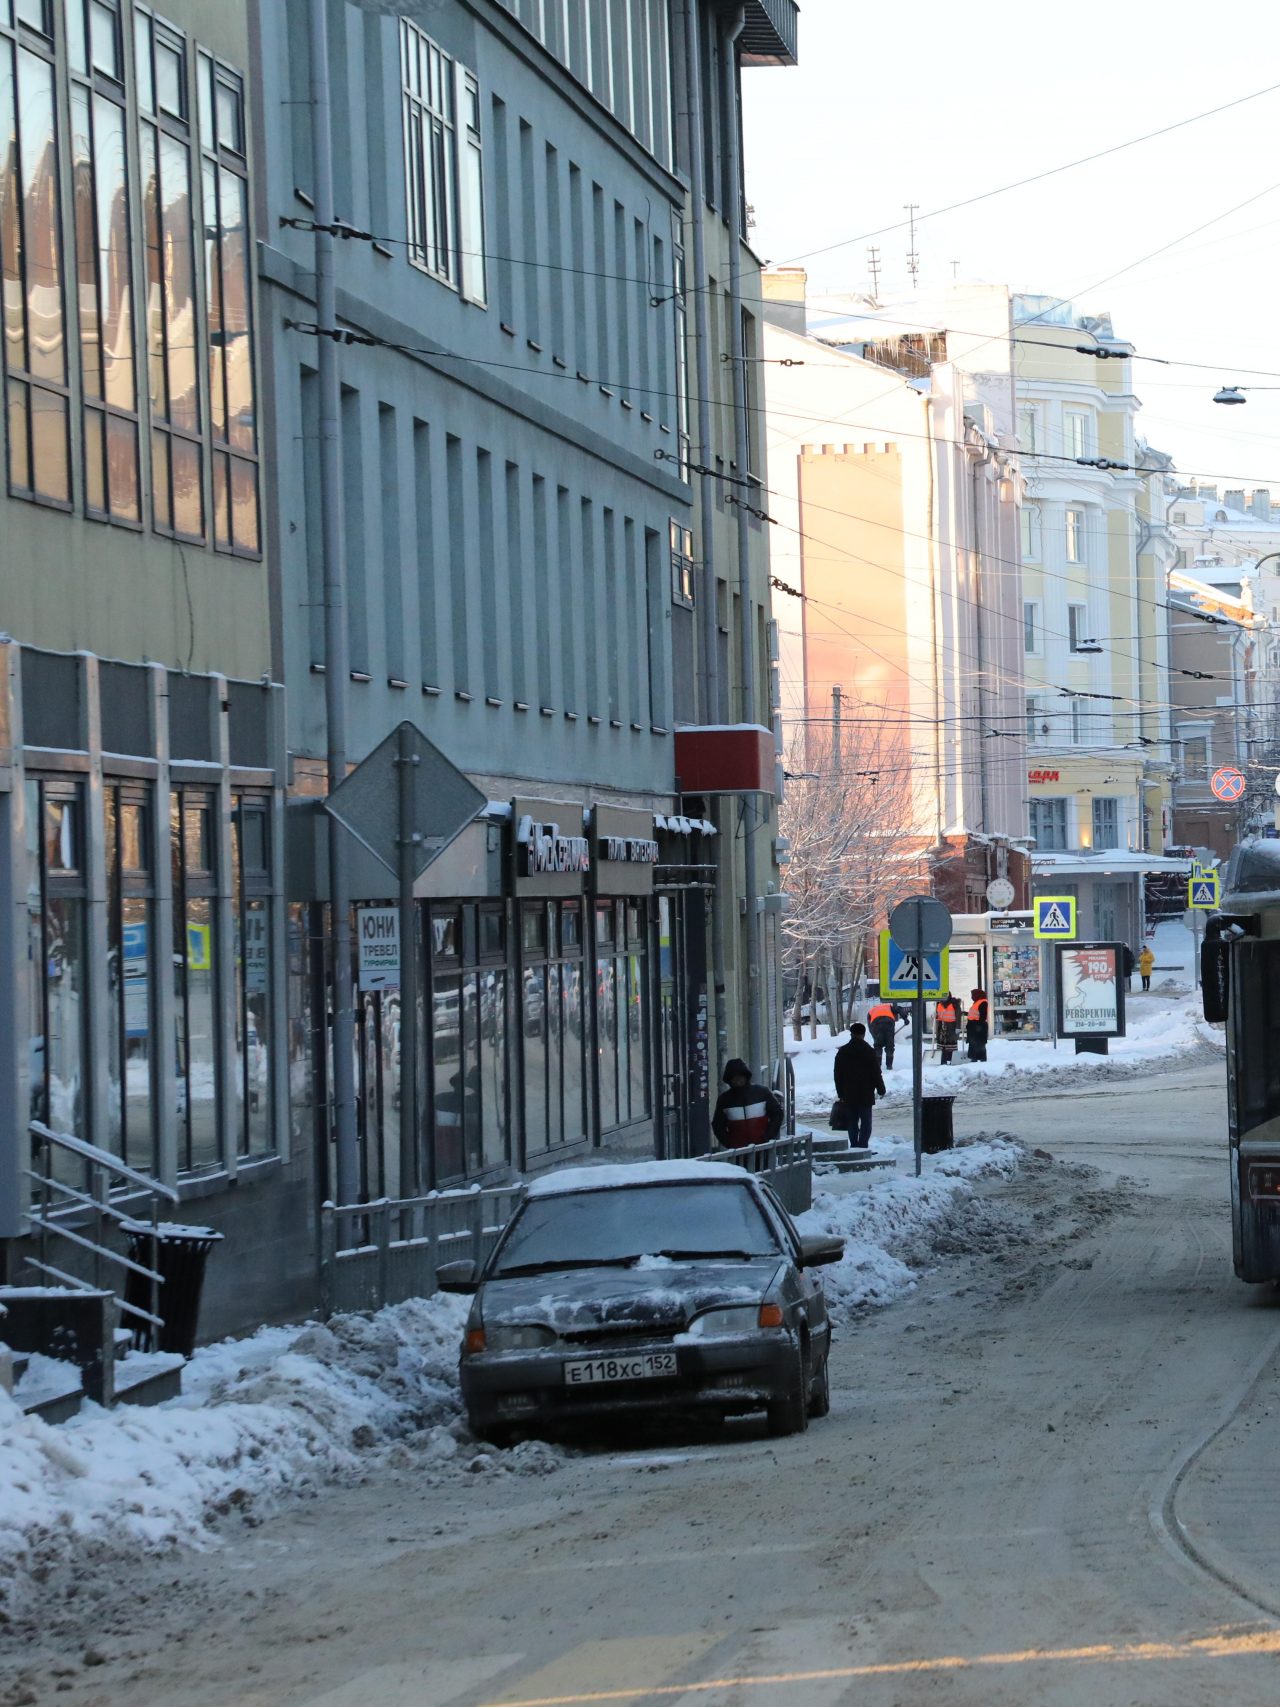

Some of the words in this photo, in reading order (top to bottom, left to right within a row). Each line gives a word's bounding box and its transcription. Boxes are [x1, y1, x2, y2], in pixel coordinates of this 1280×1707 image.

[362, 915, 395, 939] ЮНИ
[362, 944, 398, 957] ТРЕВЕЛ
[364, 959, 398, 967] ТУРФИРМА
[1088, 961, 1108, 974] 190
[1065, 1007, 1117, 1019] PERSPEKTIVA
